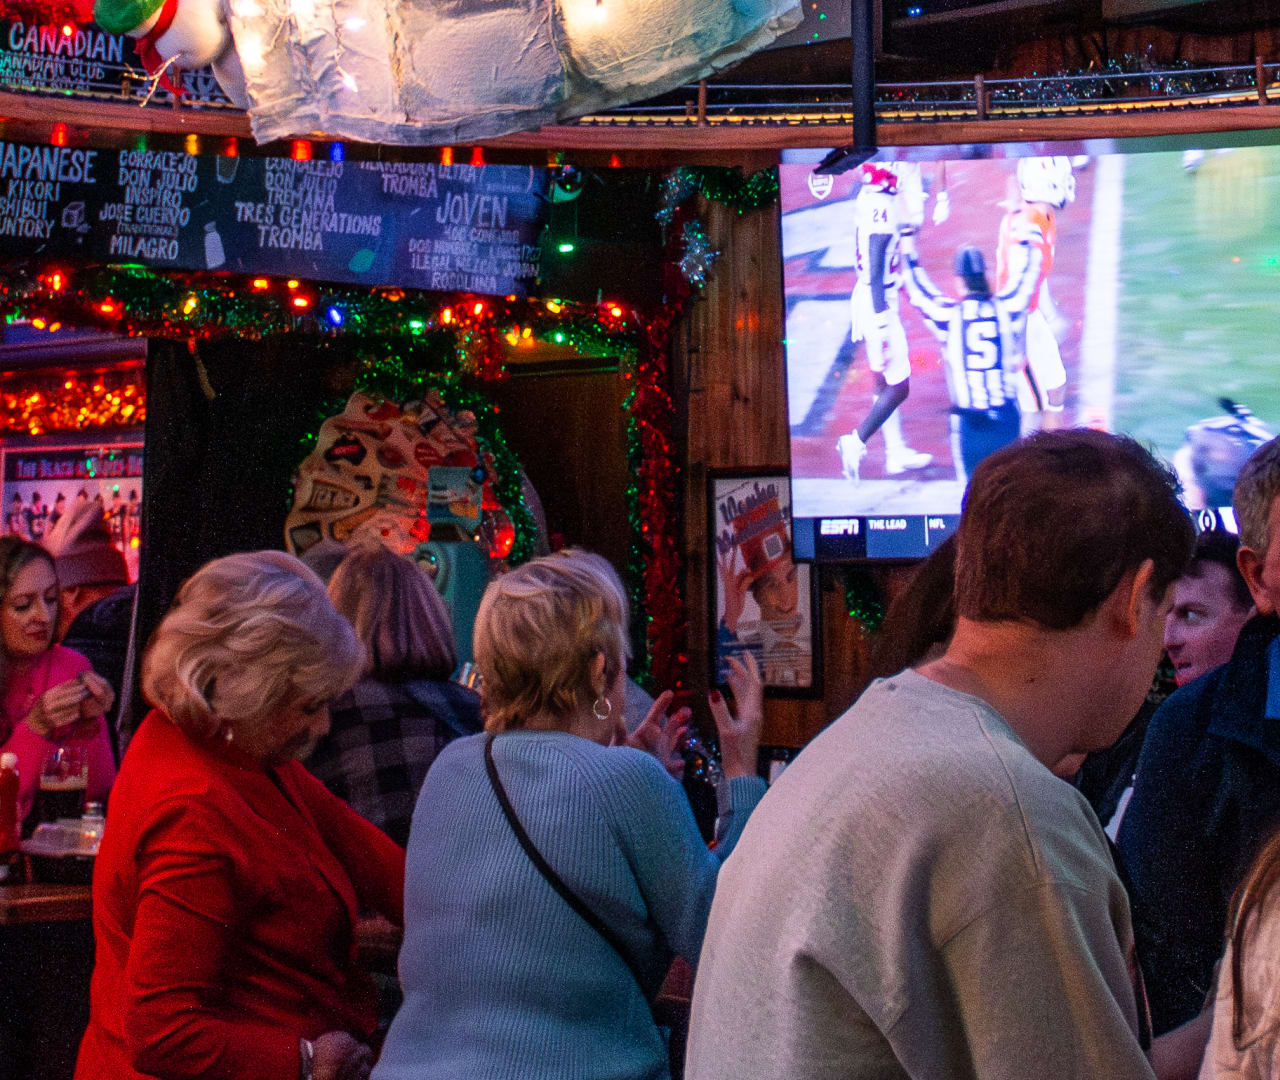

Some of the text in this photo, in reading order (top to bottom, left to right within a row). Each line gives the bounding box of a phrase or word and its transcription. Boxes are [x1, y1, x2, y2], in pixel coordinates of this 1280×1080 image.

[8, 21, 125, 62] CANADIAN
[120, 149, 198, 176] CORRALEJO
[7, 179, 61, 202] KIKORI
[118, 168, 198, 193] DON JULIO
[264, 171, 295, 190] DON
[381, 172, 438, 198] TROMBA
[124, 186, 183, 210] INSPIRO
[436, 191, 508, 228] JOVEN
[99, 202, 191, 228] JOSE CUERVO
[235, 202, 382, 235] TRES GENERATIONS
[109, 233, 180, 260] MILAGRO
[257, 224, 323, 250] TROMBA
[821, 518, 945, 535] ESPN THE LEAD NFL
